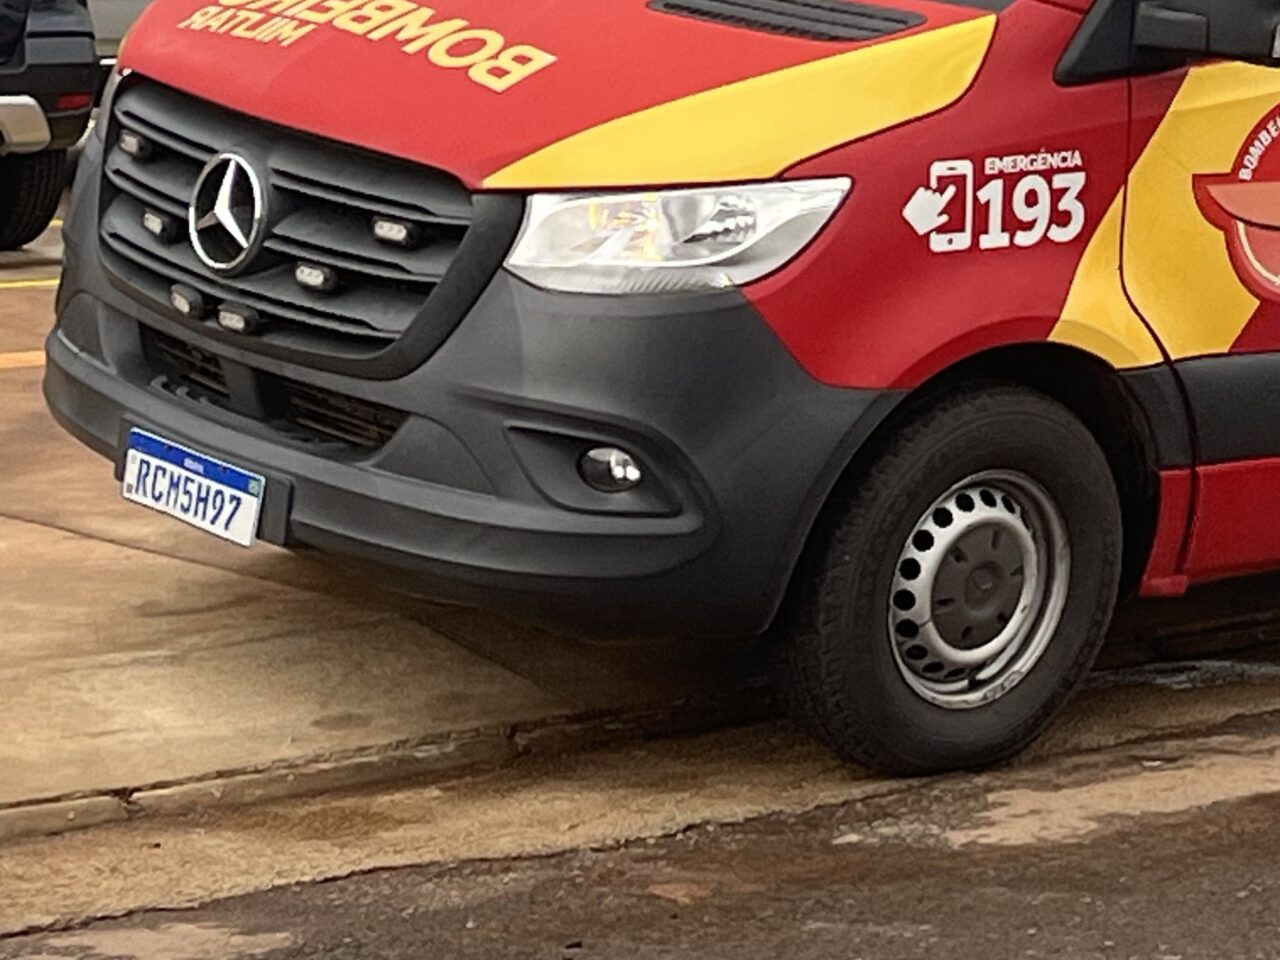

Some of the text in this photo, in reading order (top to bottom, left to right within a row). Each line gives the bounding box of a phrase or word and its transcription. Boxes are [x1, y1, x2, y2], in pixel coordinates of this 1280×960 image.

[985, 147, 1083, 174] EMERGÊNCIA
[976, 171, 1086, 250] 193
[134, 458, 243, 531] RCM5H97
